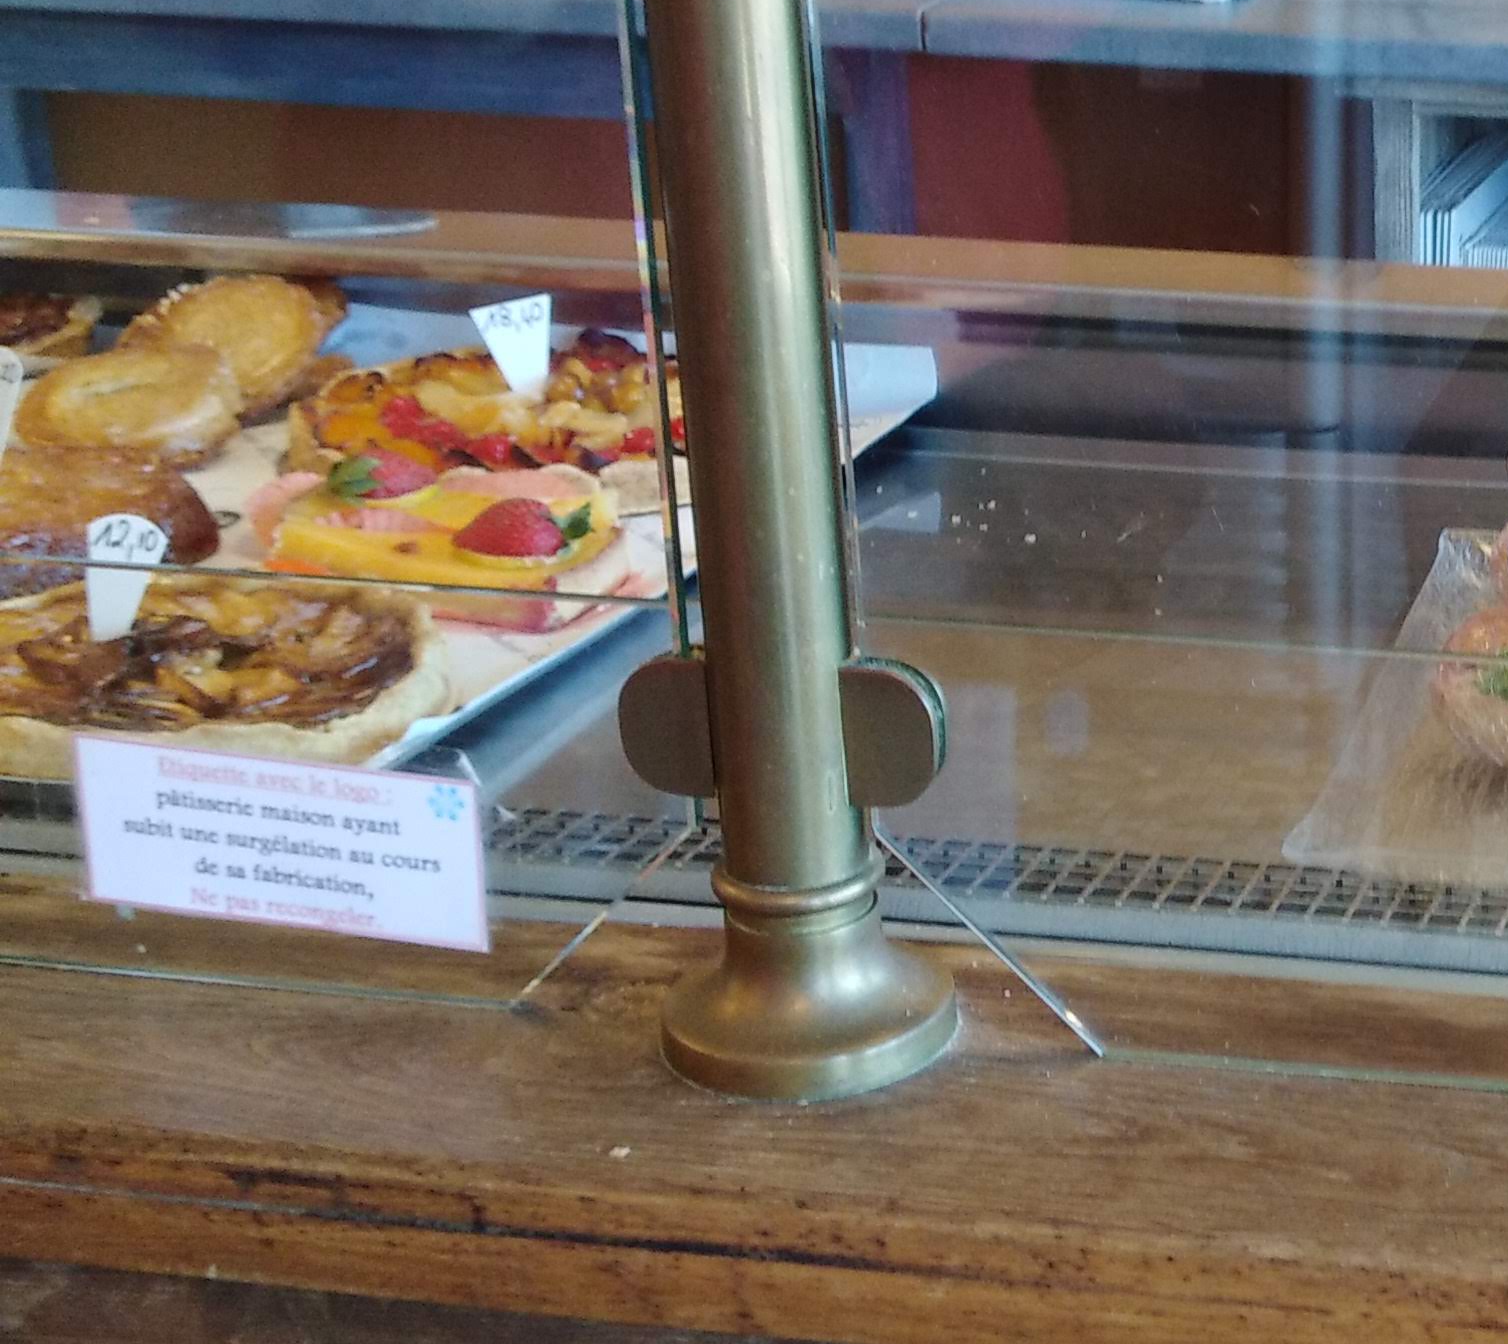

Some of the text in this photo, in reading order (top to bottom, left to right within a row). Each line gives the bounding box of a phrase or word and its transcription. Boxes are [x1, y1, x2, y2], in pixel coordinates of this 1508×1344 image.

[256, 771, 300, 790] avec
[309, 774, 325, 795] le
[335, 778, 381, 804] logo
[156, 788, 401, 837] pâtisserie maison ayant
[124, 816, 442, 874] subit une surgélation au cours
[191, 886, 219, 906] Ne
[225, 894, 258, 914] pas
[195, 857, 375, 901] de sa fabrication,
